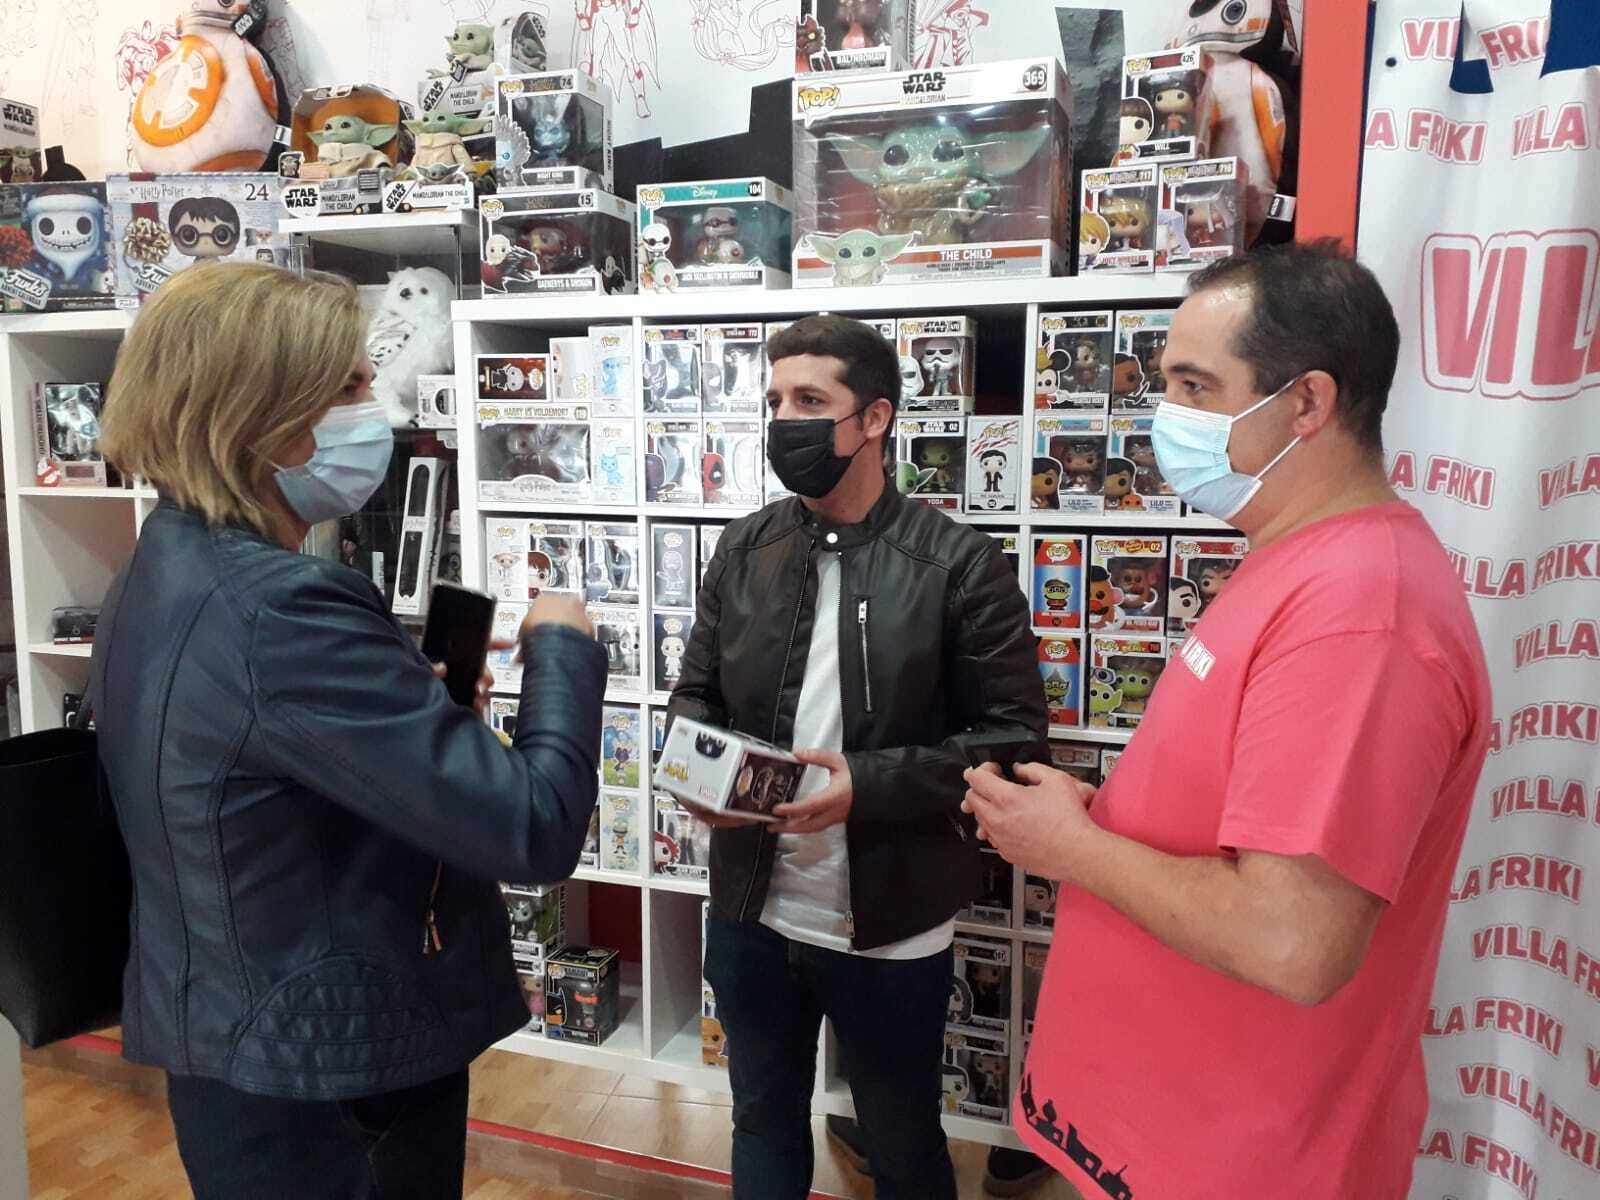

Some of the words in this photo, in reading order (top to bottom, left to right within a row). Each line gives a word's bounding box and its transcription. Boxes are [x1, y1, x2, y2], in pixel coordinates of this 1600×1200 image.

[902, 71, 946, 85] STAR
[902, 81, 946, 95] WARS
[3, 103, 34, 118] STAR
[1407, 111, 1486, 162] FRIKI
[1513, 104, 1588, 159] VILLA
[245, 183, 269, 201] 24
[285, 187, 318, 199] STAR
[286, 197, 318, 209] WARS
[580, 194, 591, 206] 15
[940, 250, 960, 262] THE
[962, 249, 992, 260] CHILD
[1425, 457, 1494, 508] FRIKI
[1150, 542, 1161, 551] 02
[1515, 621, 1600, 670] VILLA
[1507, 702, 1599, 746] FRIKI
[1491, 777, 1587, 821] VILLA
[1488, 854, 1583, 903] FRIKI
[1472, 925, 1569, 977] VILLA
[1474, 998, 1565, 1058] FRIKI
[1458, 1065, 1546, 1128] VILLA
